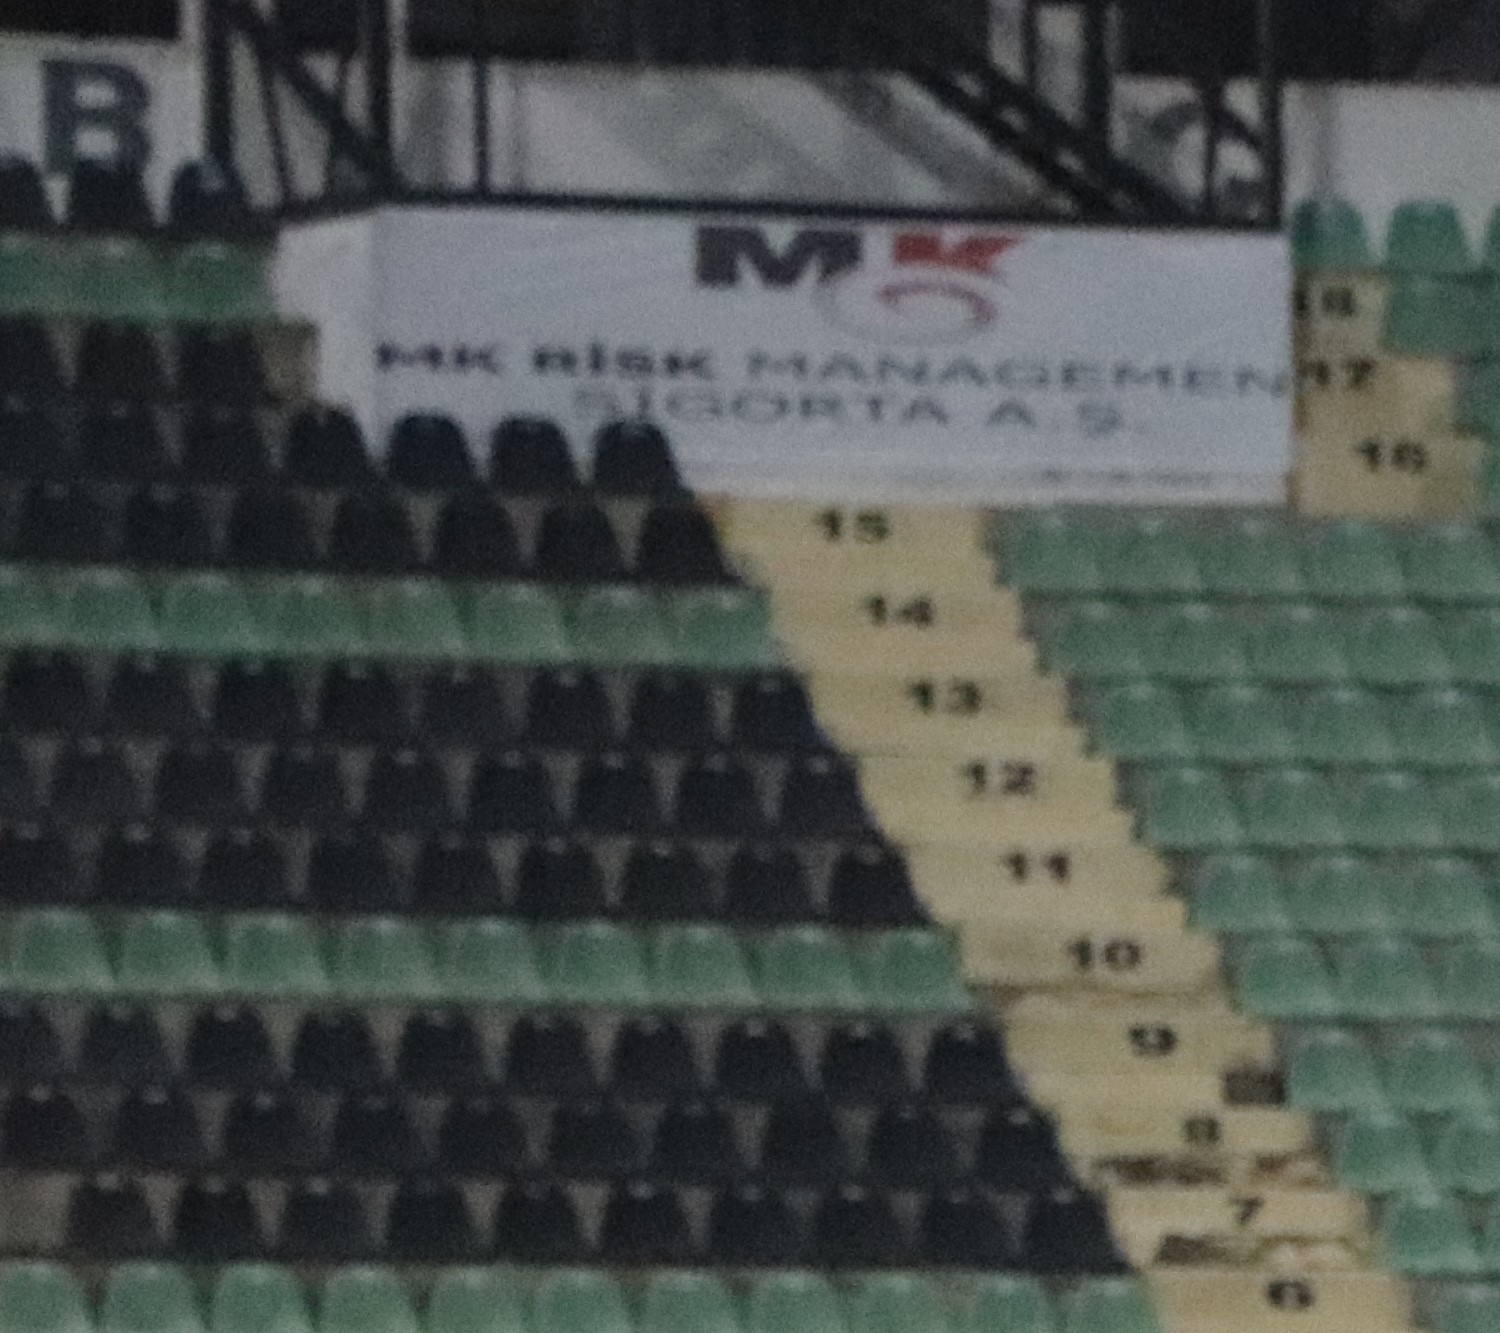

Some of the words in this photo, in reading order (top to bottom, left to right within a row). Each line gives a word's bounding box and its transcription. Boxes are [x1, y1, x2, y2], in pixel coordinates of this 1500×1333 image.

[376, 341, 497, 378] MK
[815, 508, 891, 543] 15
[864, 596, 934, 628] 14
[907, 678, 982, 716] 13
[963, 760, 1036, 797] 12
[1003, 852, 1070, 884] 11
[1067, 937, 1145, 971] 10
[1233, 1198, 1264, 1227] 7
